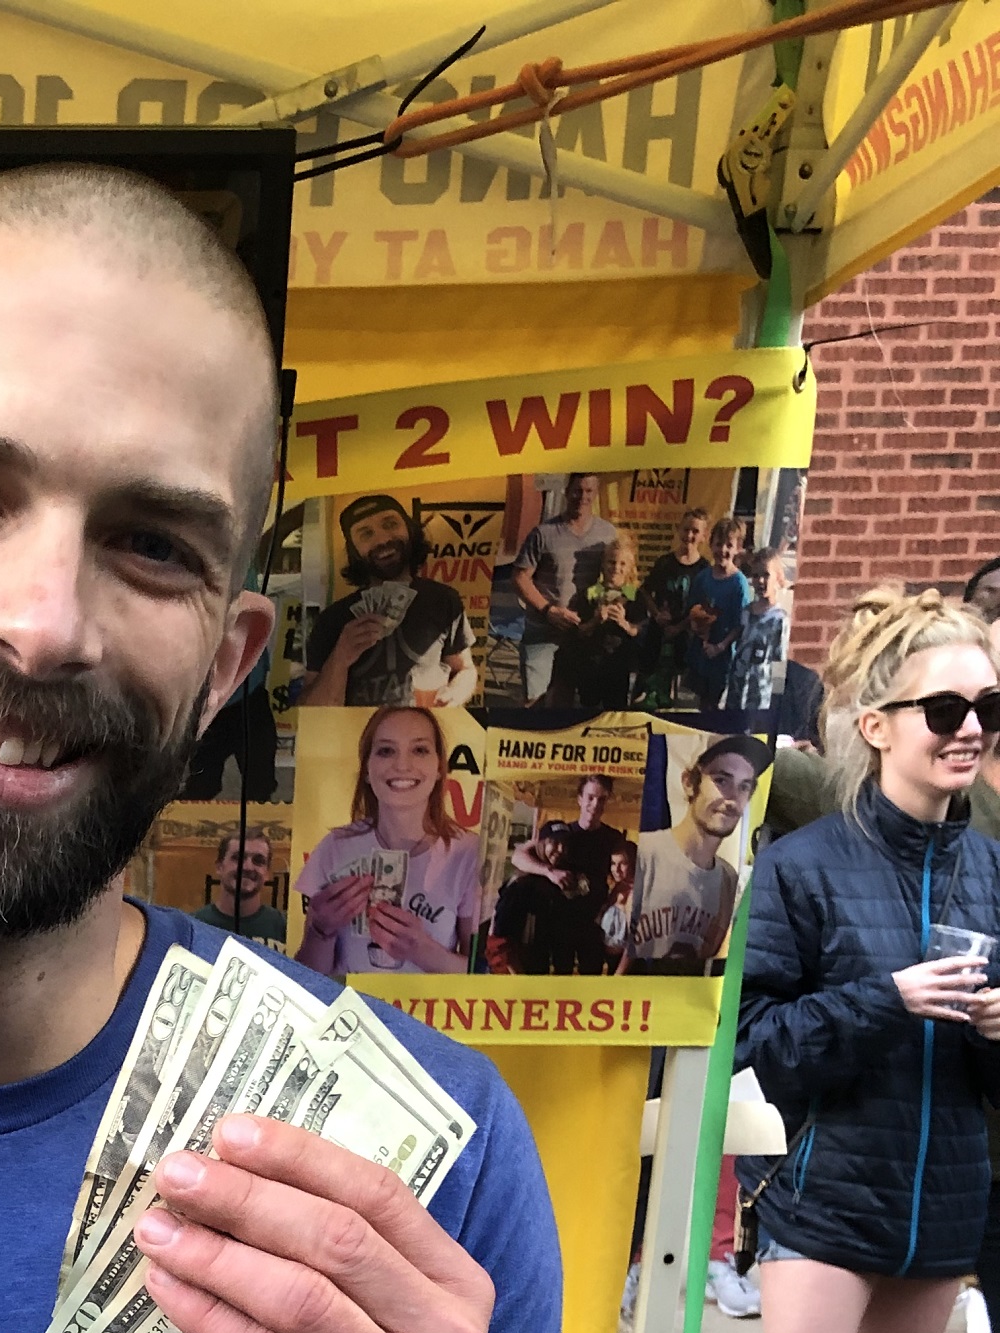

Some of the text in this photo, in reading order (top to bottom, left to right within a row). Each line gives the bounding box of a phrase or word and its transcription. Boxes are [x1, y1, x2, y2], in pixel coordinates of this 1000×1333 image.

[394, 404, 452, 471] 2
[485, 374, 756, 457] WIN?
[498, 738, 546, 760] HANG
[551, 743, 587, 763] FOR
[592, 745, 622, 764] 100
[498, 760, 528, 769] HANG
[531, 760, 543, 770] AT
[548, 763, 578, 773] YOUR
